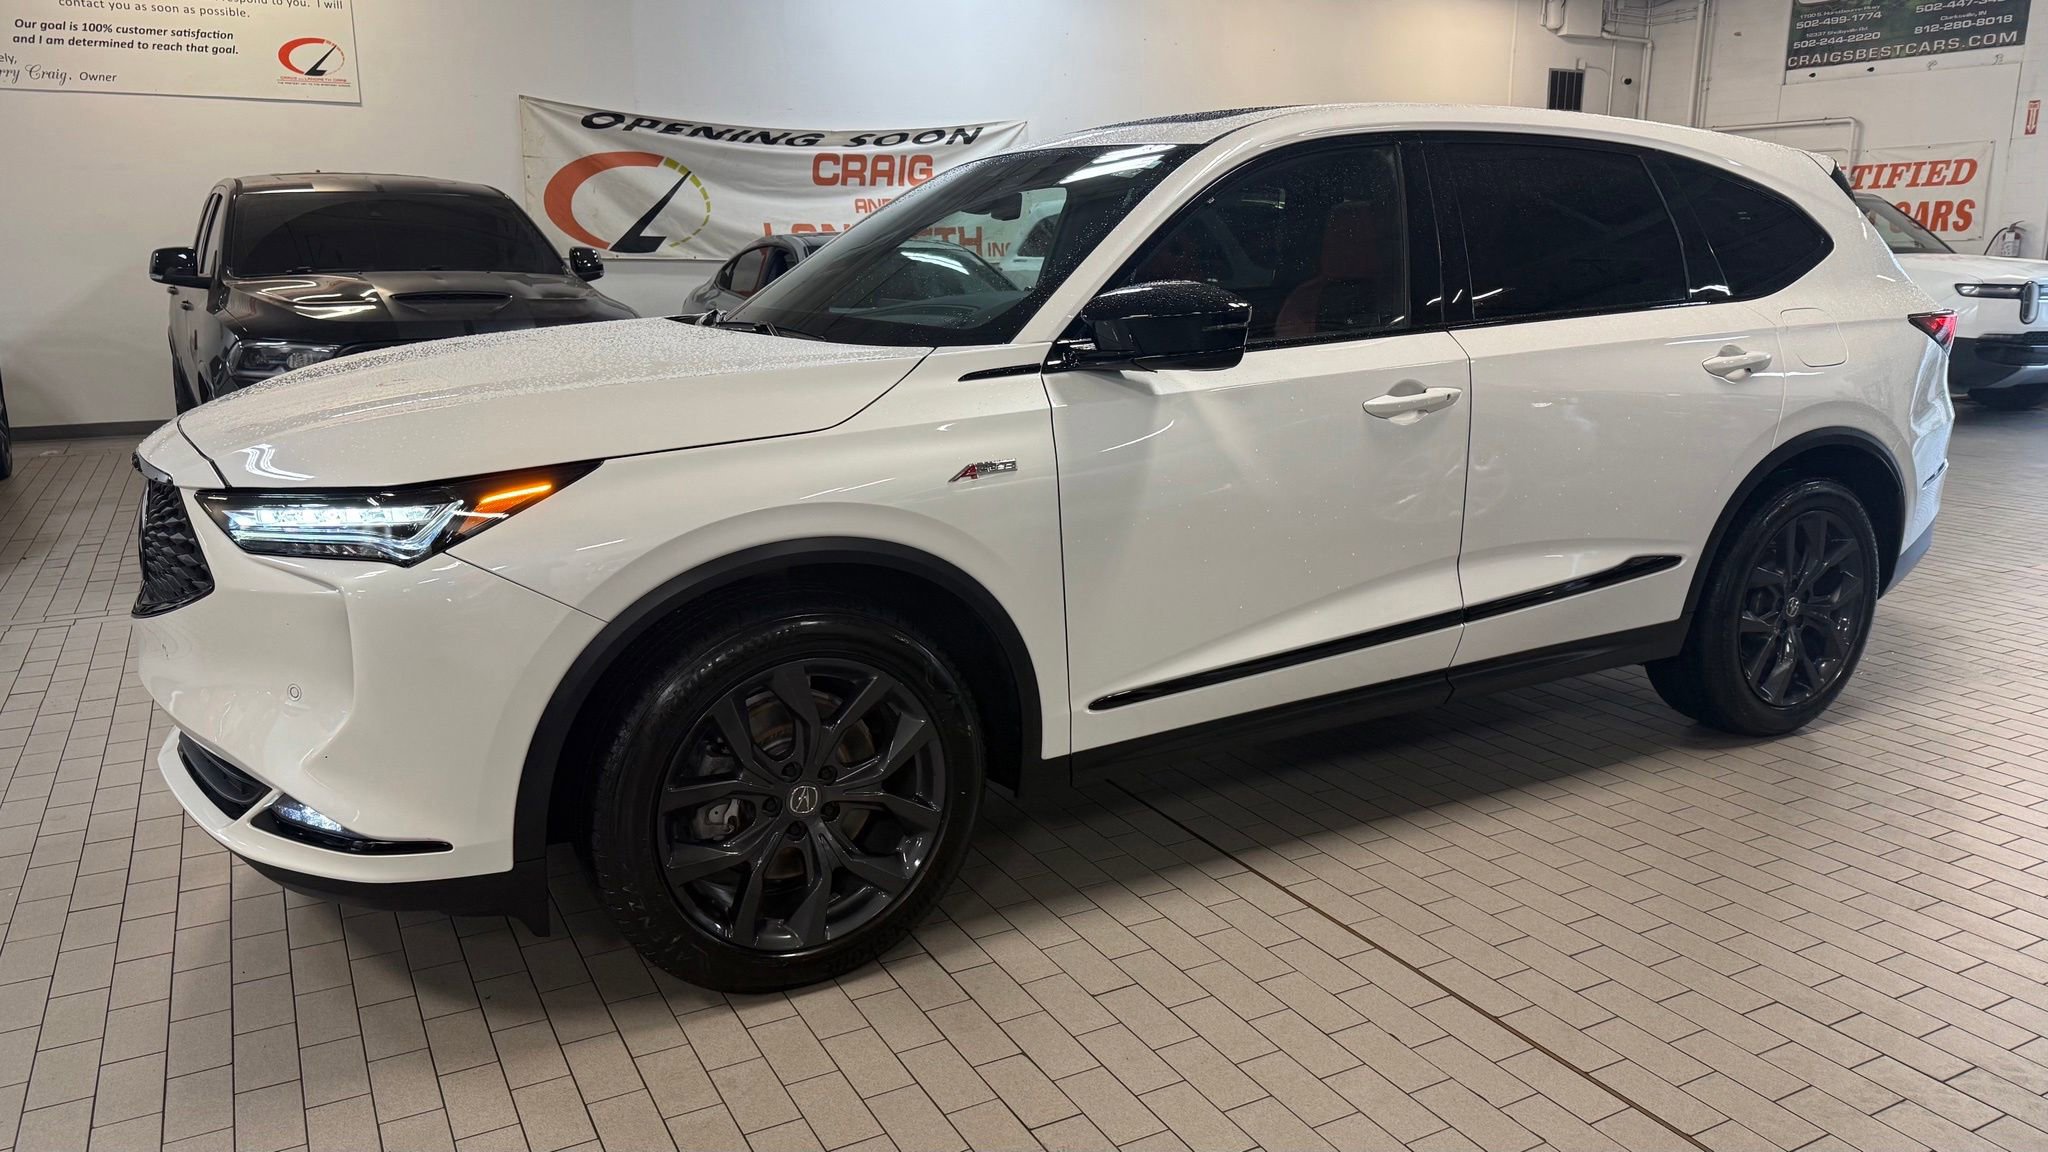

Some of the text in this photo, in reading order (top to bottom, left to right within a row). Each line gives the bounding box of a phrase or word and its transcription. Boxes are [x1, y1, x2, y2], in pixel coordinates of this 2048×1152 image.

[58, 0, 250, 18] contact you as soon as possible.
[286, 0, 310, 8] you.
[324, 0, 343, 9] will
[1915, 0, 2005, 13] 502-447-3
[14, 18, 234, 40] Our goal is 100% customer satisfaction
[1796, 11, 1882, 29] 502-499-1774
[1914, 14, 2013, 34] 812-280-8018
[12, 35, 239, 56] and I am determined to reach that goal.
[1788, 31, 2018, 67] CRAIGSBESTCARS.COM
[1793, 31, 1881, 49] 502-244-2220
[79, 71, 117, 82] Owner
[581, 112, 984, 147] OPENING SOON
[812, 153, 933, 187] CRAIG
[1841, 158, 1978, 190] TIFIED
